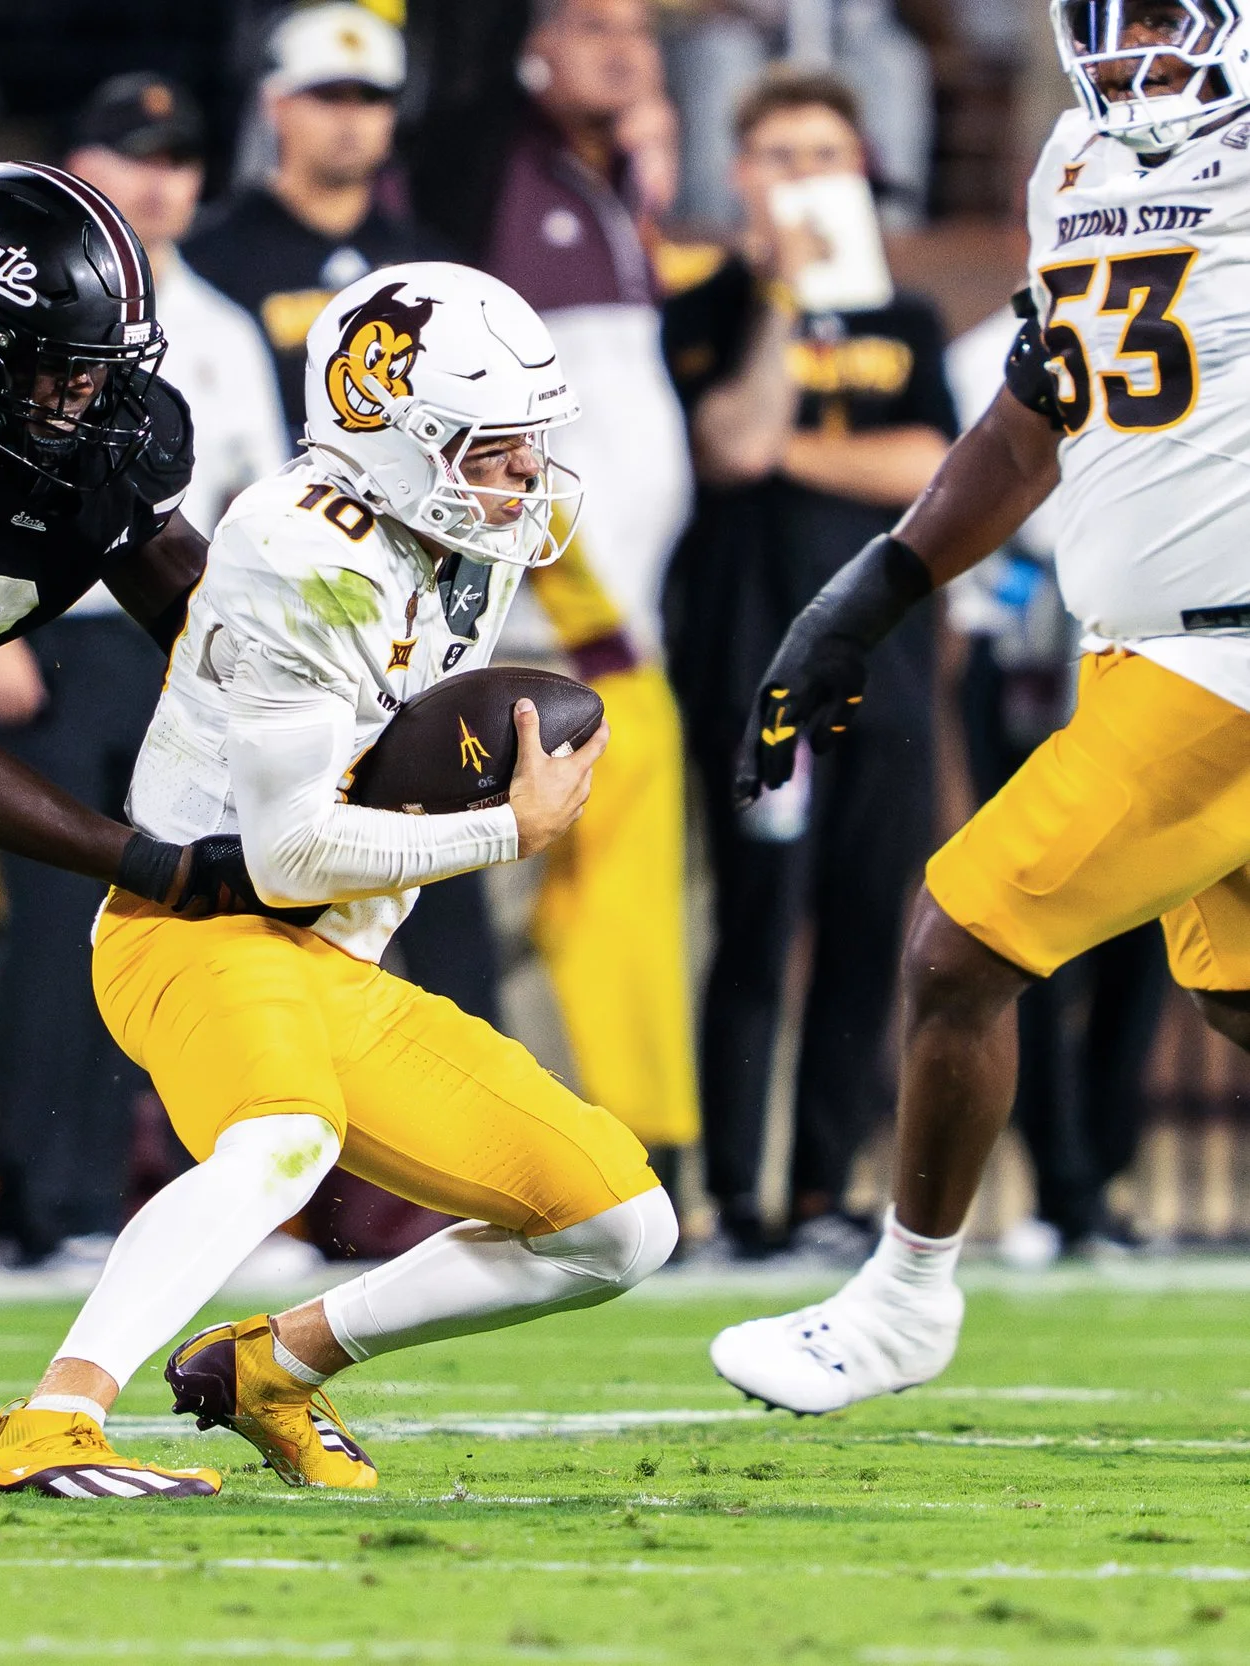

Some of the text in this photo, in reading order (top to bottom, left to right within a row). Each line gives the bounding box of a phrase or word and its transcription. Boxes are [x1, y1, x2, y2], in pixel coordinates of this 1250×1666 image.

[1056, 205, 1213, 247] RIZONA STATE
[1038, 246, 1200, 437] 53
[10, 511, 46, 532] State
[295, 483, 377, 543] 10
